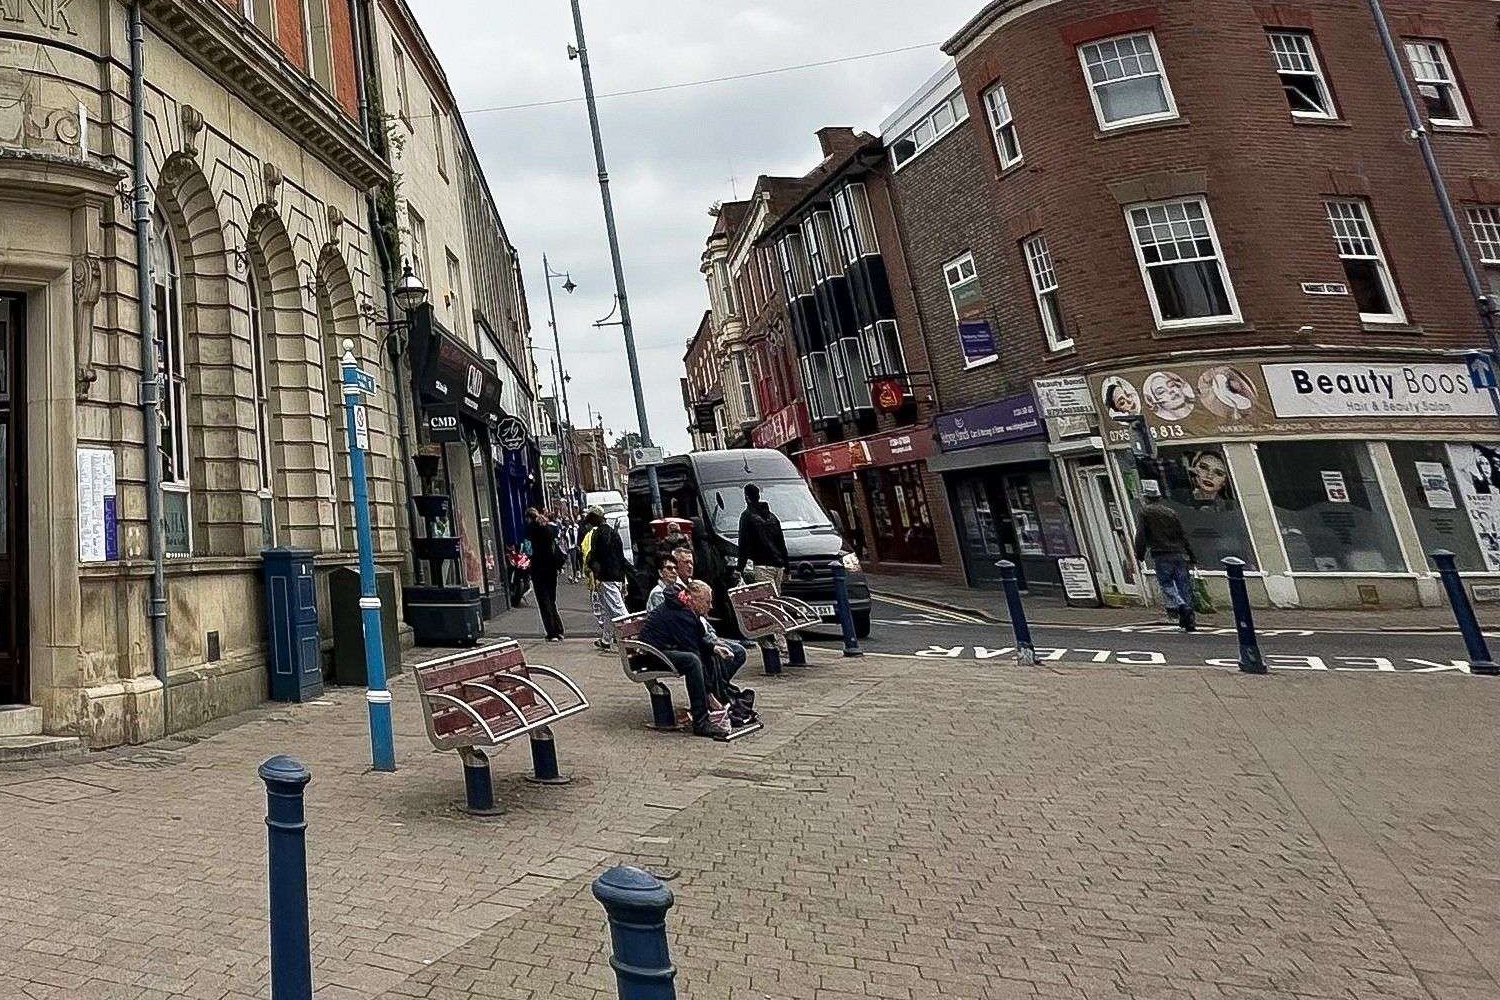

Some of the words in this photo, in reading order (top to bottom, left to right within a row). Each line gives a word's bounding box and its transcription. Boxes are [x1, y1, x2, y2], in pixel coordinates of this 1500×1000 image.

[1290, 369, 1394, 399] Beauty
[1347, 401, 1369, 411] Hair
[1371, 401, 1380, 411] &
[1382, 401, 1420, 412] Beauty
[1421, 401, 1453, 411] Salon
[431, 416, 457, 428] CMD
[913, 645, 1168, 665] CLEAR
